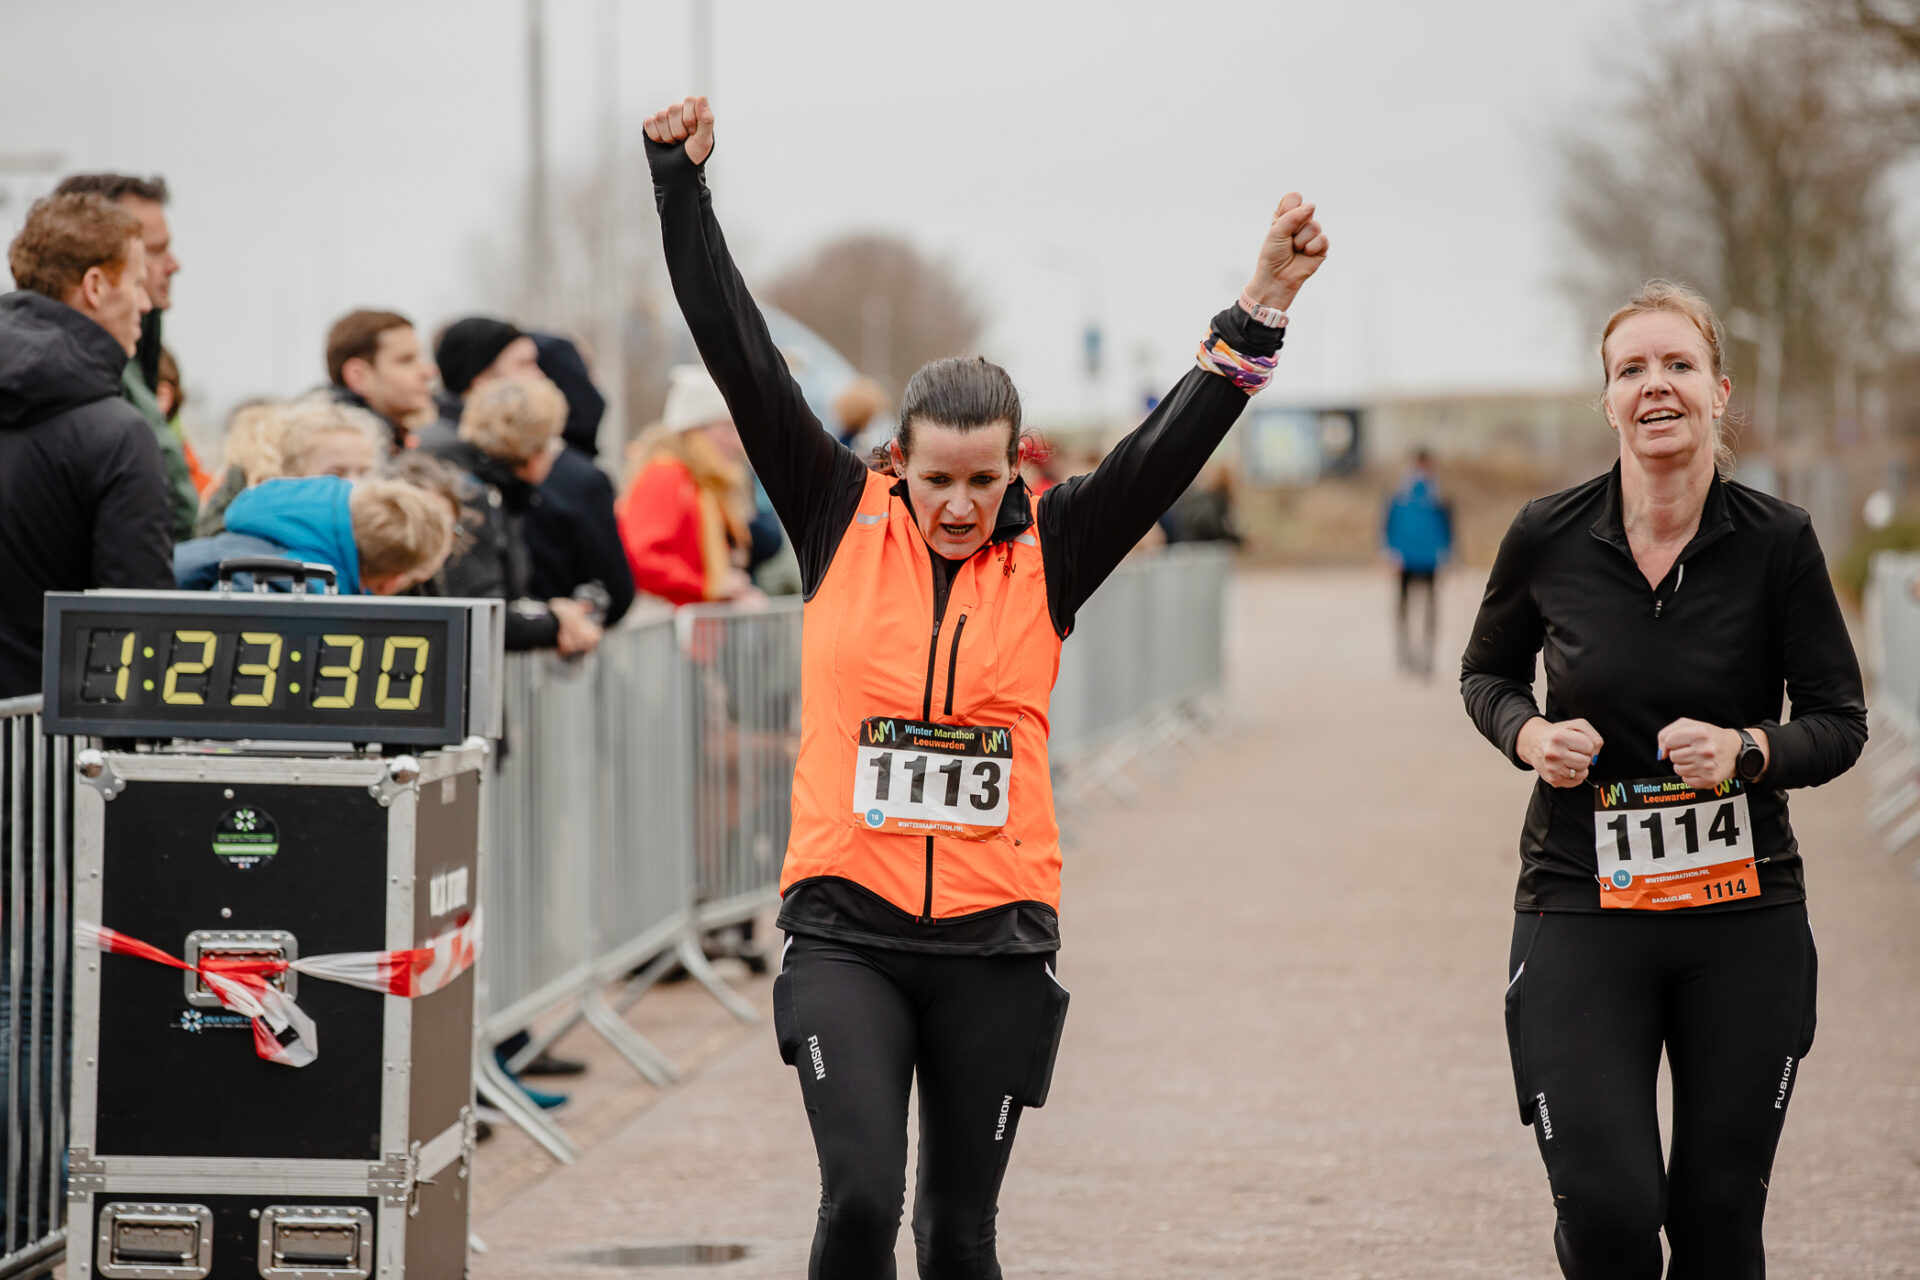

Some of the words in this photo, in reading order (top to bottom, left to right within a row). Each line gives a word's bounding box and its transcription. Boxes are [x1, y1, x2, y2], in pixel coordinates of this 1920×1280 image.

[115, 629, 430, 711] 1:23:30
[904, 724, 933, 737] Winter
[934, 729, 975, 740] Marathon
[913, 736, 965, 750] Leeuwarden
[869, 752, 1001, 811] 1113
[1633, 784, 1661, 793] Winter
[1662, 782, 1692, 791] Marat
[1643, 791, 1696, 804] Leeuwarden
[1607, 802, 1740, 860] 1114
[1644, 869, 1710, 884] WINTERMARATHON.FRL
[1703, 878, 1748, 900] 1114
[1651, 893, 1693, 904] BAGAGELABEL
[807, 1034, 826, 1080] FUSION
[1774, 1056, 1793, 1109] FUSION
[995, 1095, 1013, 1140] FUSION
[1536, 1092, 1553, 1140] FUSION
